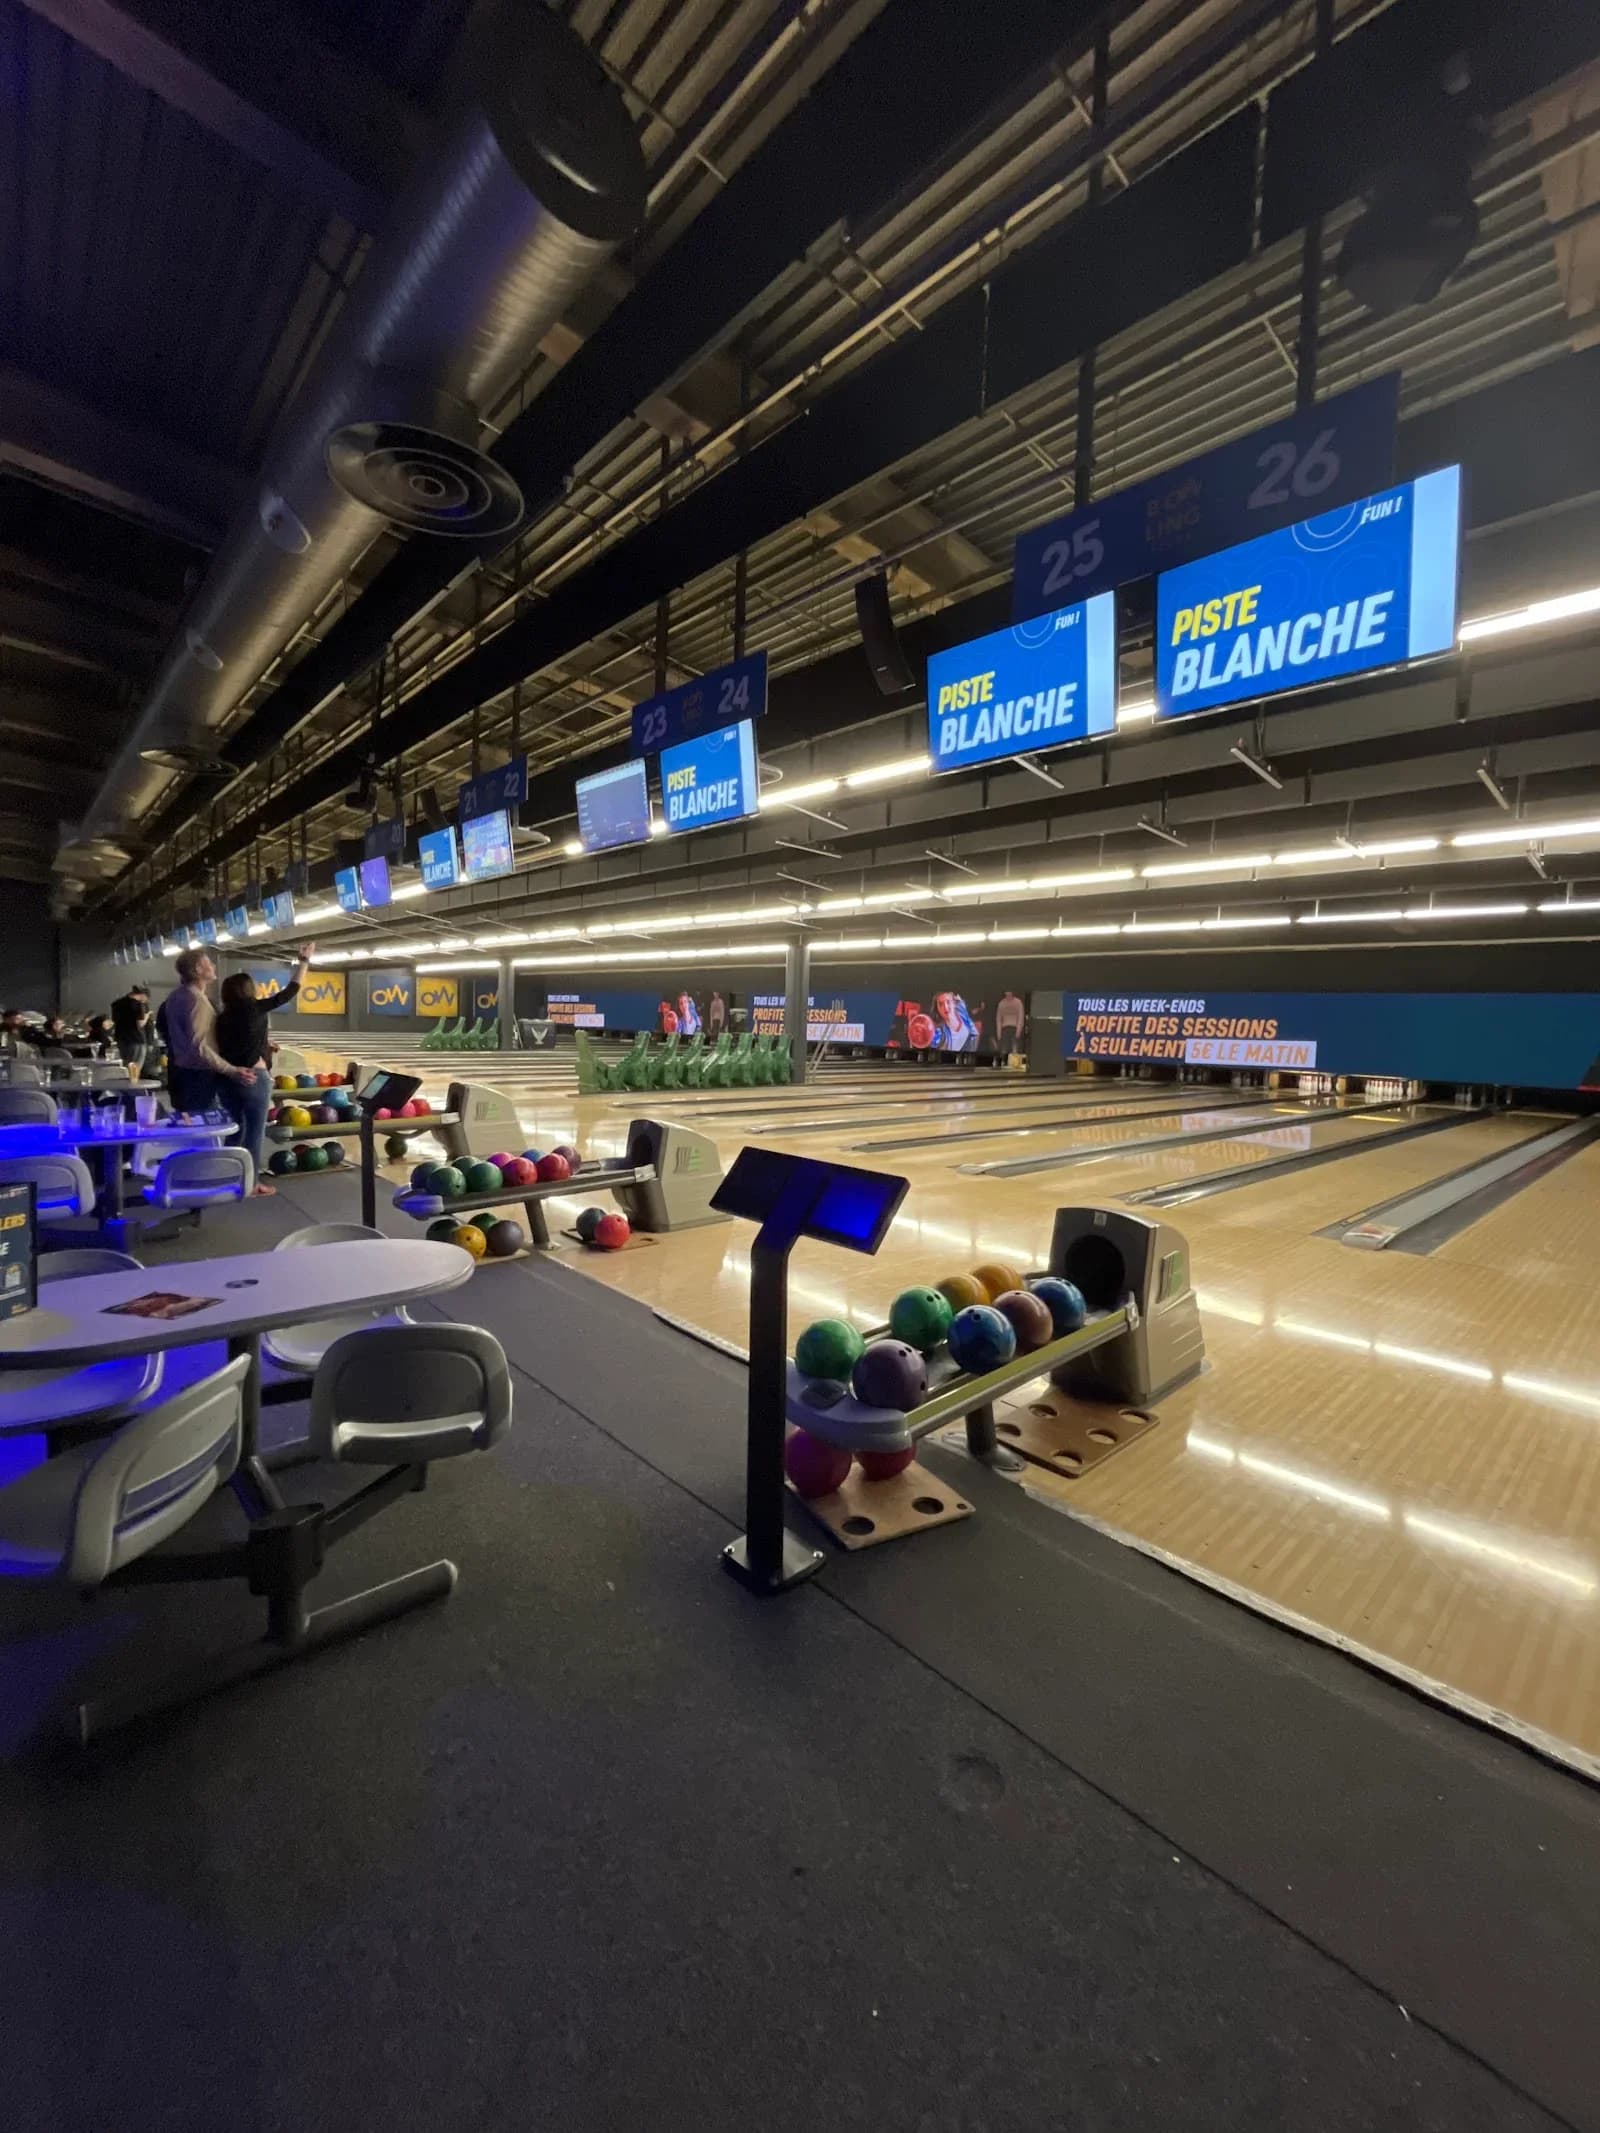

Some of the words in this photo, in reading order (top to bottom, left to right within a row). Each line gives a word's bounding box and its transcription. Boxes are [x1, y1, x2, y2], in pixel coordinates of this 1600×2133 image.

[1247, 427, 1340, 509] 26
[1040, 518, 1105, 594] 25
[1171, 585, 1262, 646] PISTE
[1171, 589, 1395, 697] BLANCHE
[717, 675, 749, 714] 24
[938, 671, 996, 715] PISTE
[642, 705, 668, 746] 23
[939, 682, 1078, 755] BLANCHE
[504, 772, 520, 797] 22
[667, 765, 697, 793] PISTE
[464, 786, 477, 814] 21
[669, 778, 738, 822] BLANCHE
[302, 981, 342, 1003] OW
[372, 984, 408, 1006] OW
[420, 986, 455, 1007] OW
[1077, 998, 1106, 1012] TOUS
[1107, 999, 1129, 1013] LES
[1131, 999, 1205, 1014] WEEK-ENDS
[753, 1008, 785, 1021] PROFITE
[1076, 1015, 1143, 1034] PROFITE
[1144, 1017, 1179, 1036] DES
[1181, 1018, 1278, 1039] SESSIONS
[1074, 1031, 1086, 1053] À
[1088, 1036, 1188, 1059] SEULEMENT
[1216, 1043, 1242, 1061] LE
[1244, 1043, 1310, 1066] MATIN
